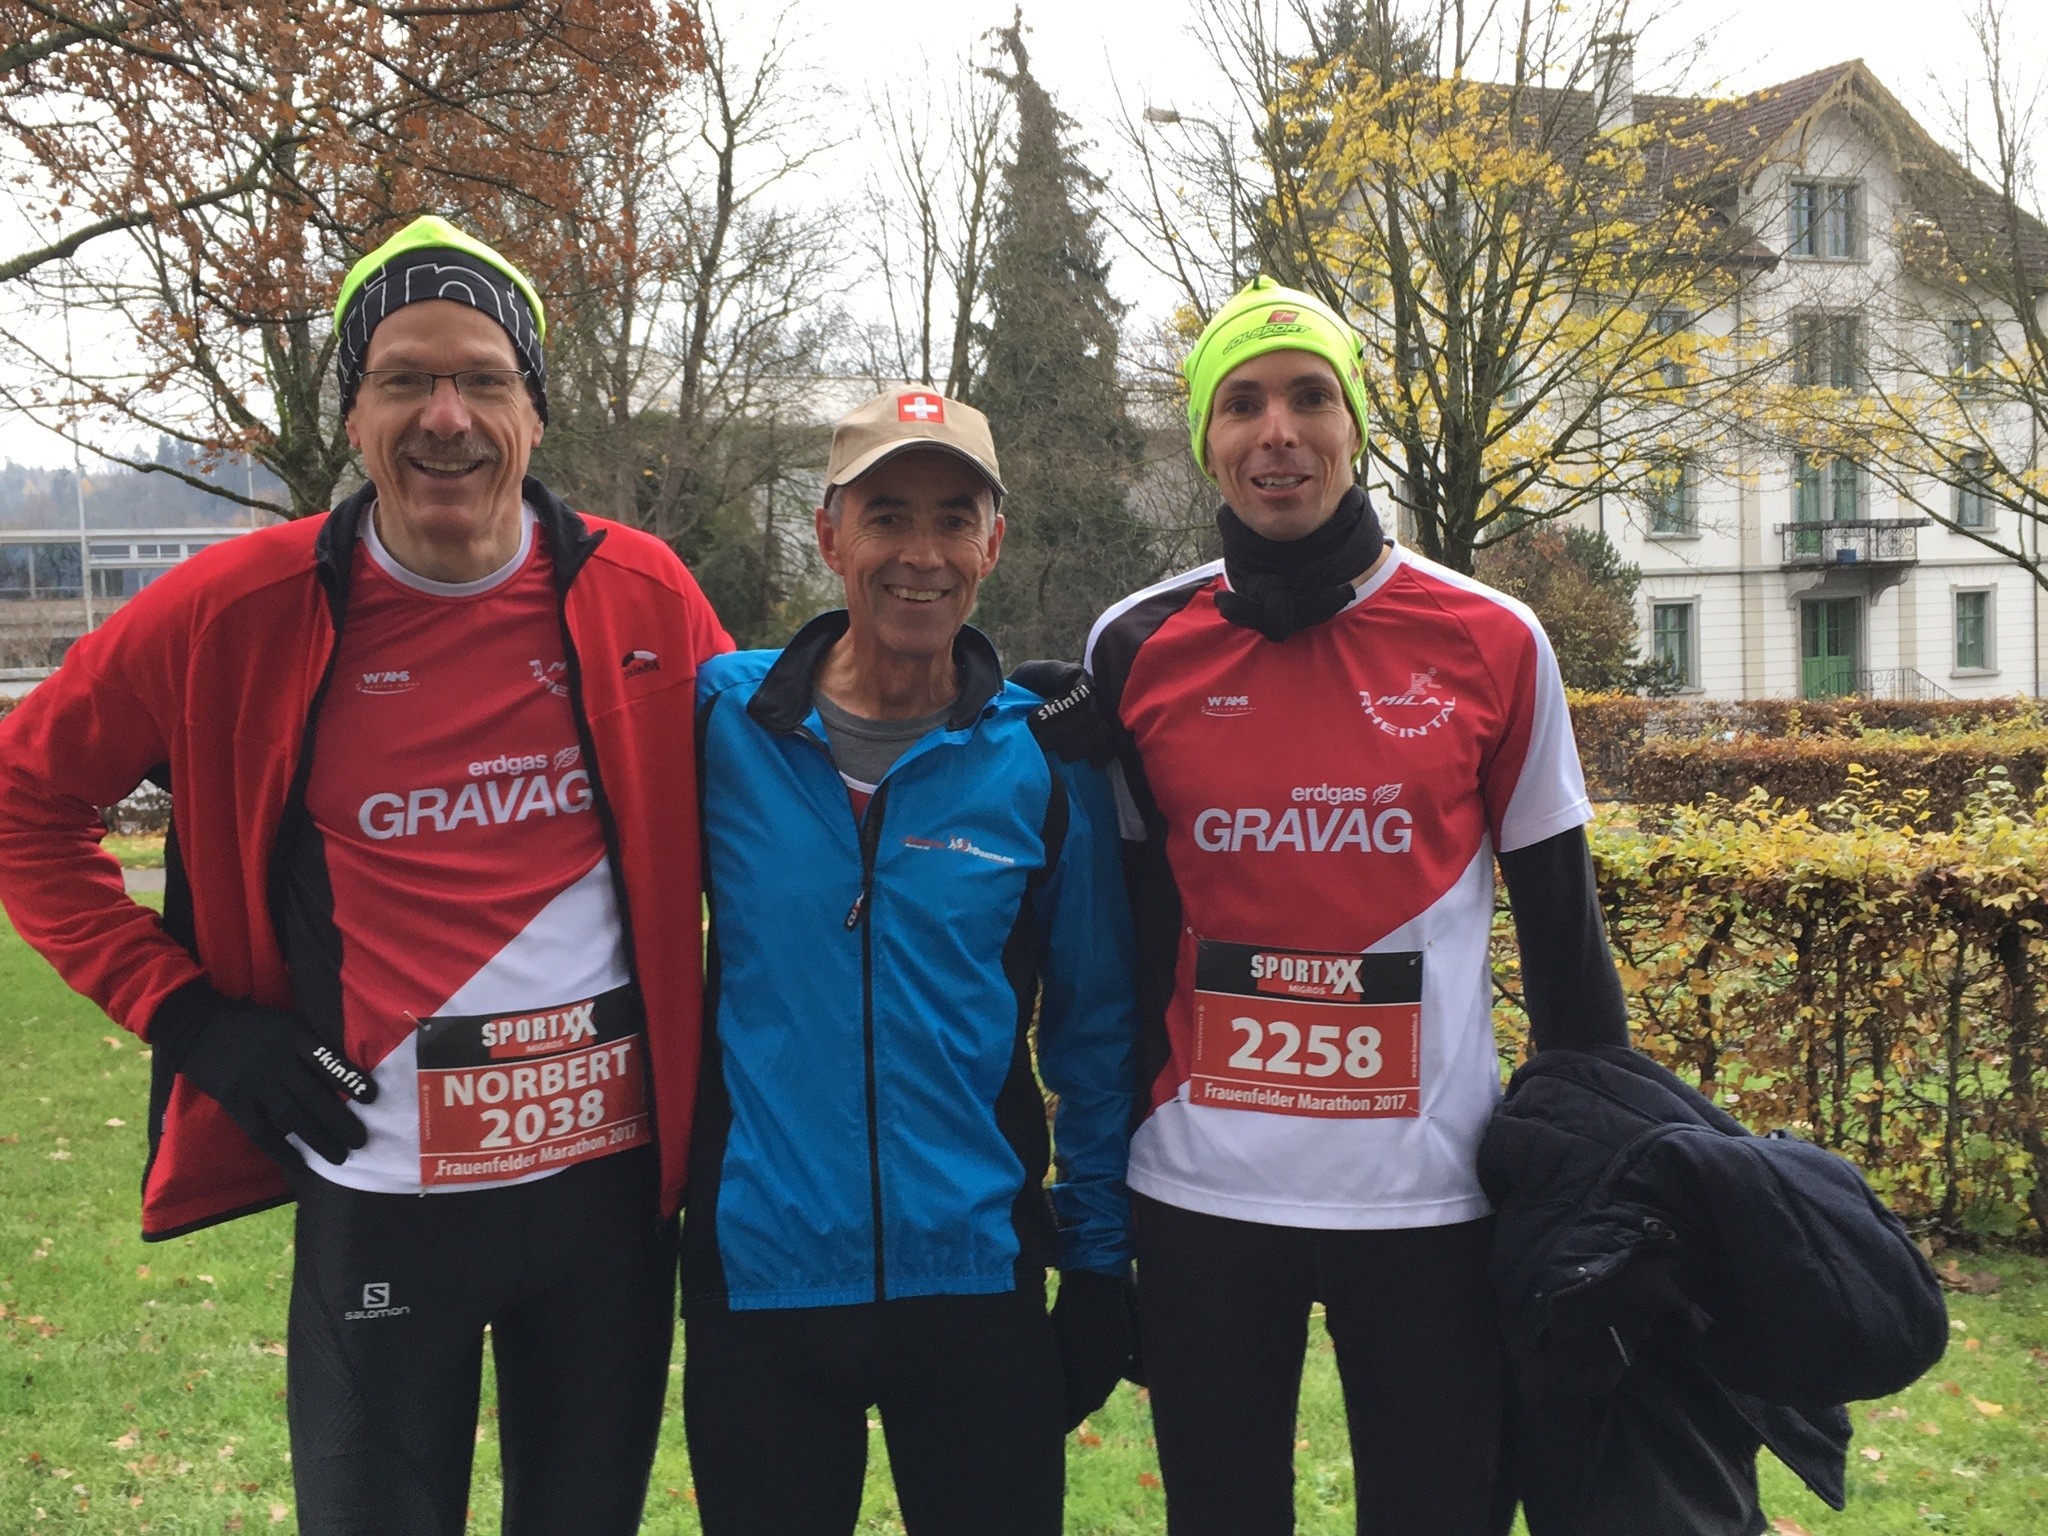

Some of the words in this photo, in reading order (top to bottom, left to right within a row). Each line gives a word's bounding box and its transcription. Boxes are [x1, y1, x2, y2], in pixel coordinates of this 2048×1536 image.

[1359, 690, 1456, 738] RHEINTAL
[468, 753, 548, 776] erdgas
[358, 769, 594, 840] GRAVAG
[1291, 783, 1367, 805] erdgas
[1193, 808, 1413, 853] GRAVAG
[312, 1046, 367, 1096] skinfit
[1228, 1016, 1383, 1079] 2258
[444, 1042, 631, 1107] NORBERT
[1205, 1082, 1295, 1108] Frauenfelder
[1297, 1093, 1370, 1111] Marathon
[1373, 1094, 1408, 1110] 2017
[480, 1089, 606, 1149] 2038
[437, 1153, 537, 1176] Frauenfelder
[540, 1135, 608, 1163] Marathon
[609, 1122, 637, 1144] 2017
